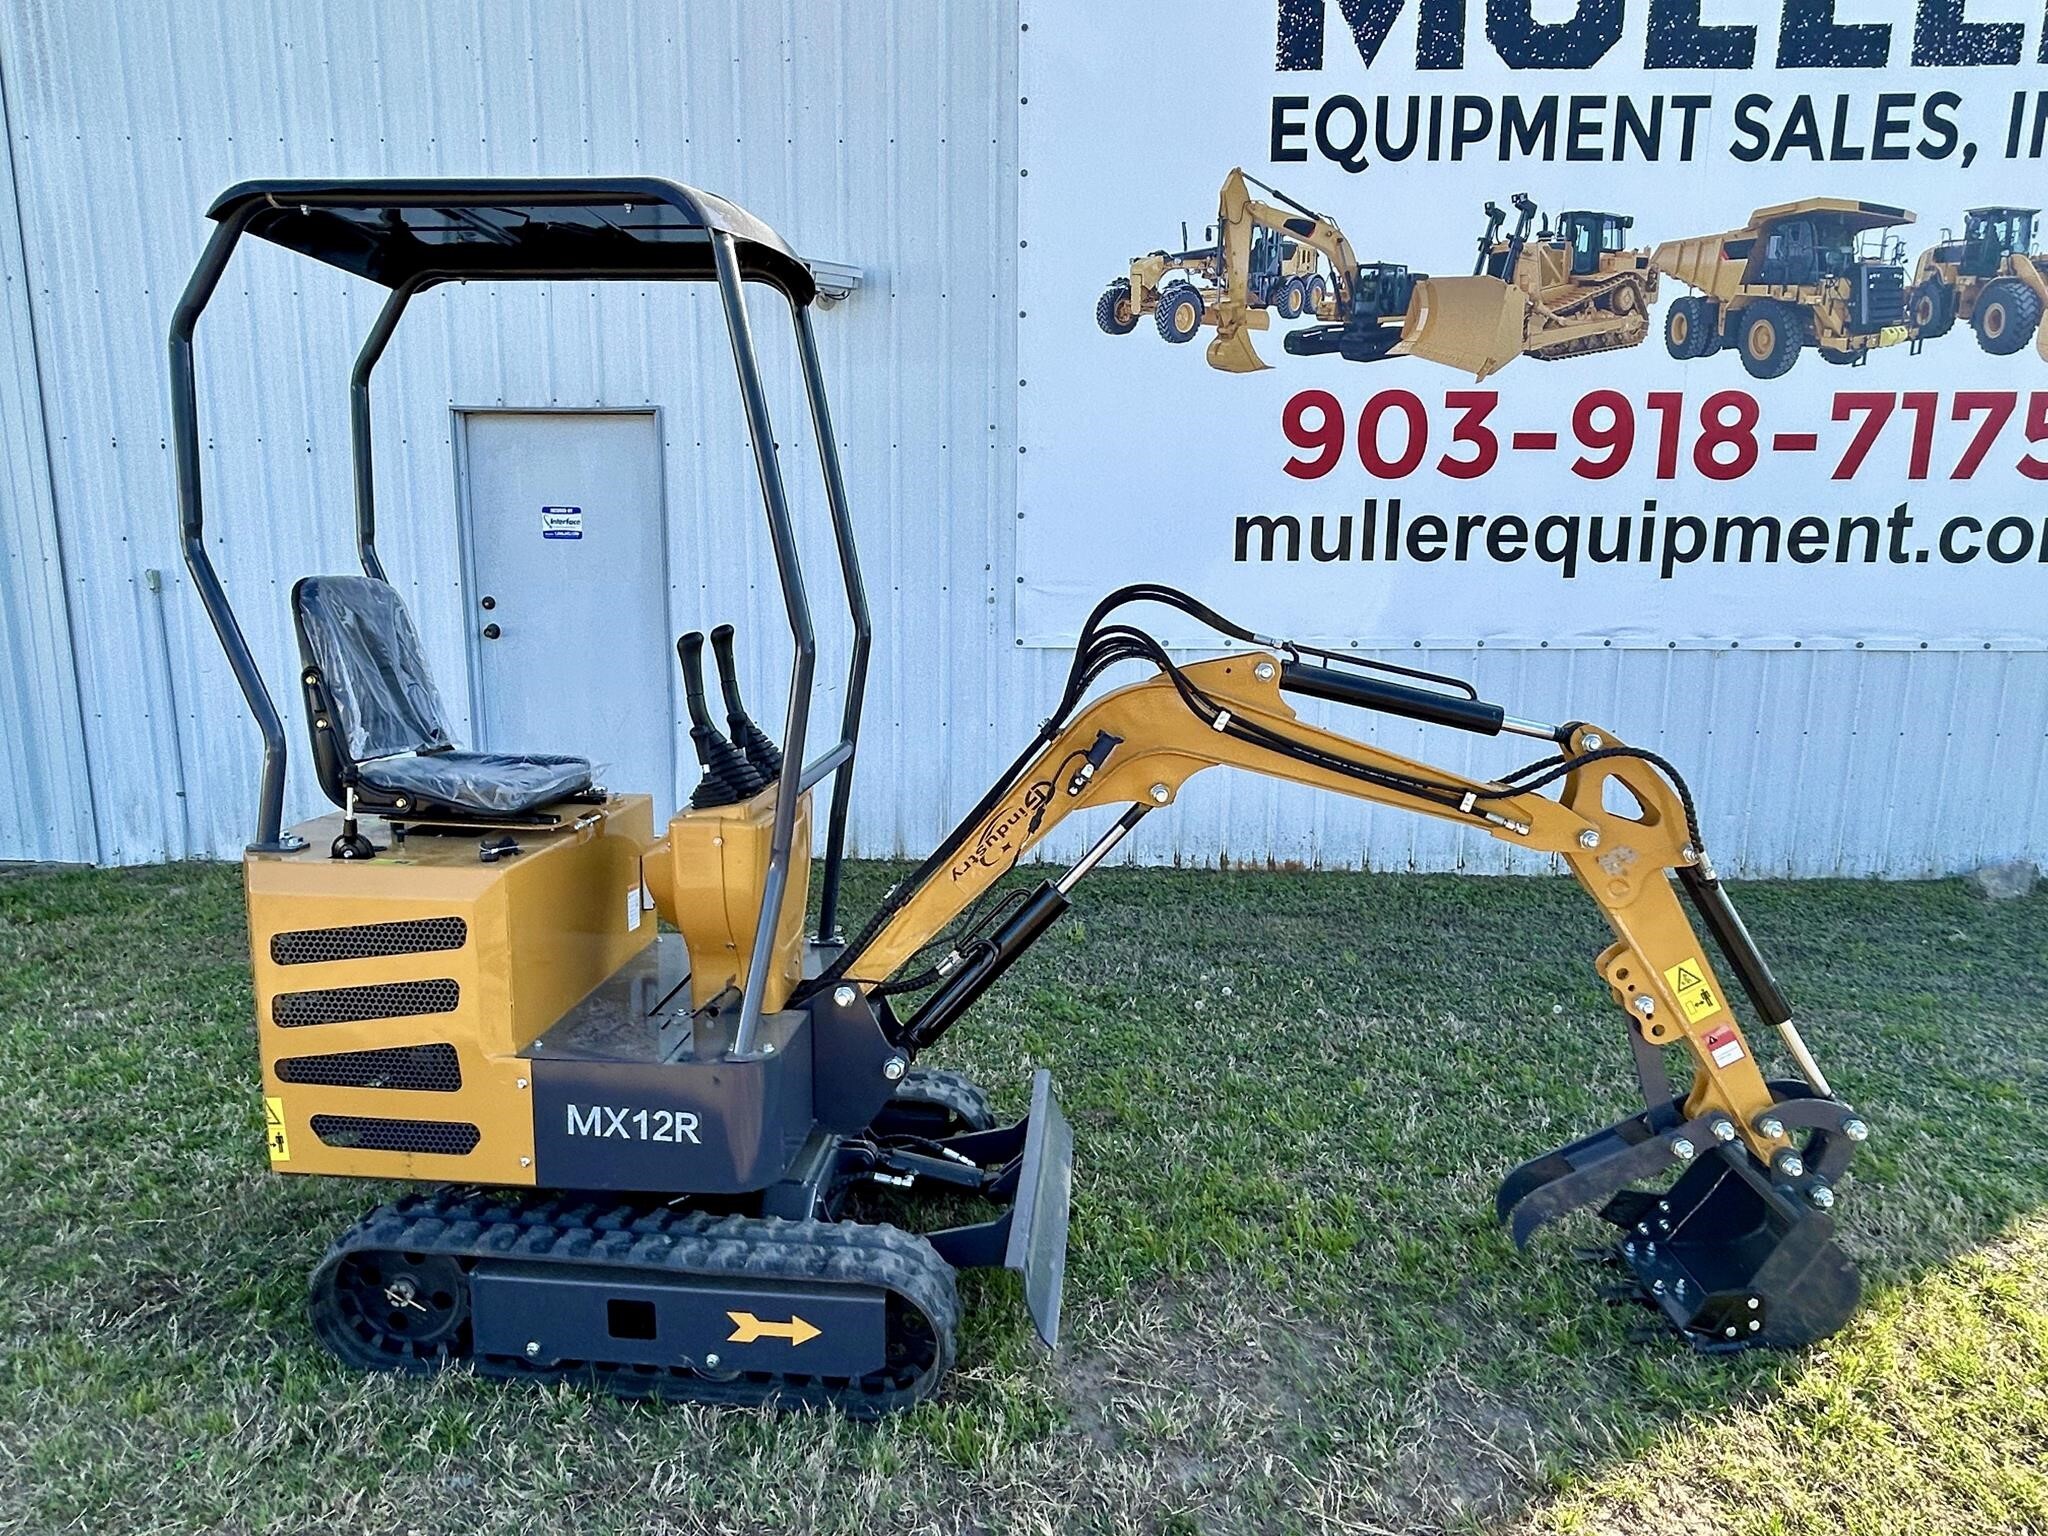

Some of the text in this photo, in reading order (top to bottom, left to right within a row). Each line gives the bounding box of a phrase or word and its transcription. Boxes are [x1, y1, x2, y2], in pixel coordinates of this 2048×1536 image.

[1270, 94, 1712, 174] EQUIPMENT
[1729, 91, 1978, 168] SALES,
[1234, 498, 2048, 579] mullerequipment.co
[567, 1104, 701, 1144] MX12R
